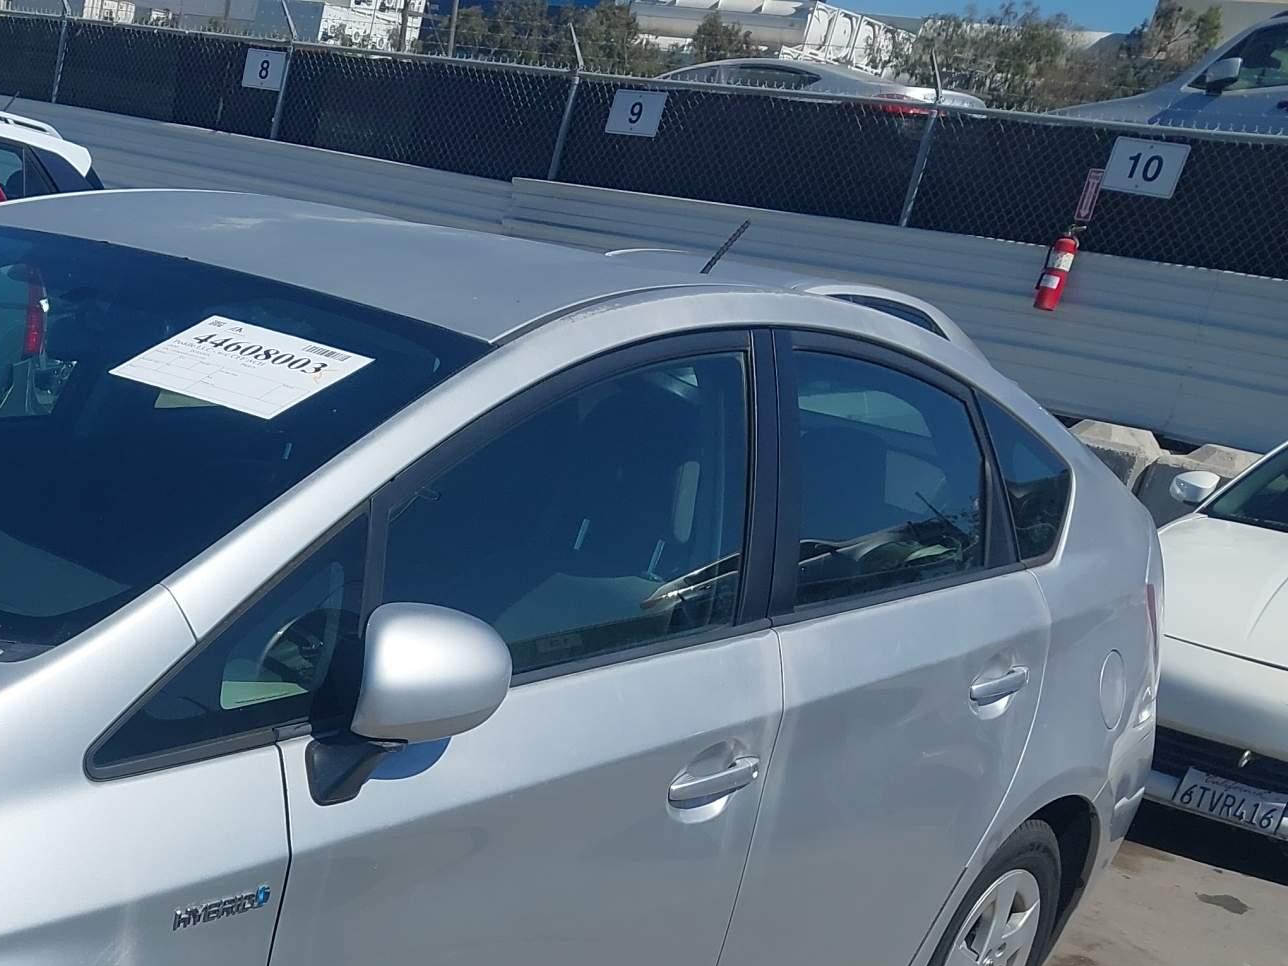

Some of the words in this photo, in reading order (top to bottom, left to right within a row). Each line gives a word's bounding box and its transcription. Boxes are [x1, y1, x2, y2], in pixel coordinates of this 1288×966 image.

[258, 59, 270, 80] 8
[628, 101, 643, 124] 9
[1128, 152, 1164, 182] 10
[192, 333, 329, 375] 44608003
[1179, 784, 1279, 830] 6TVR416
